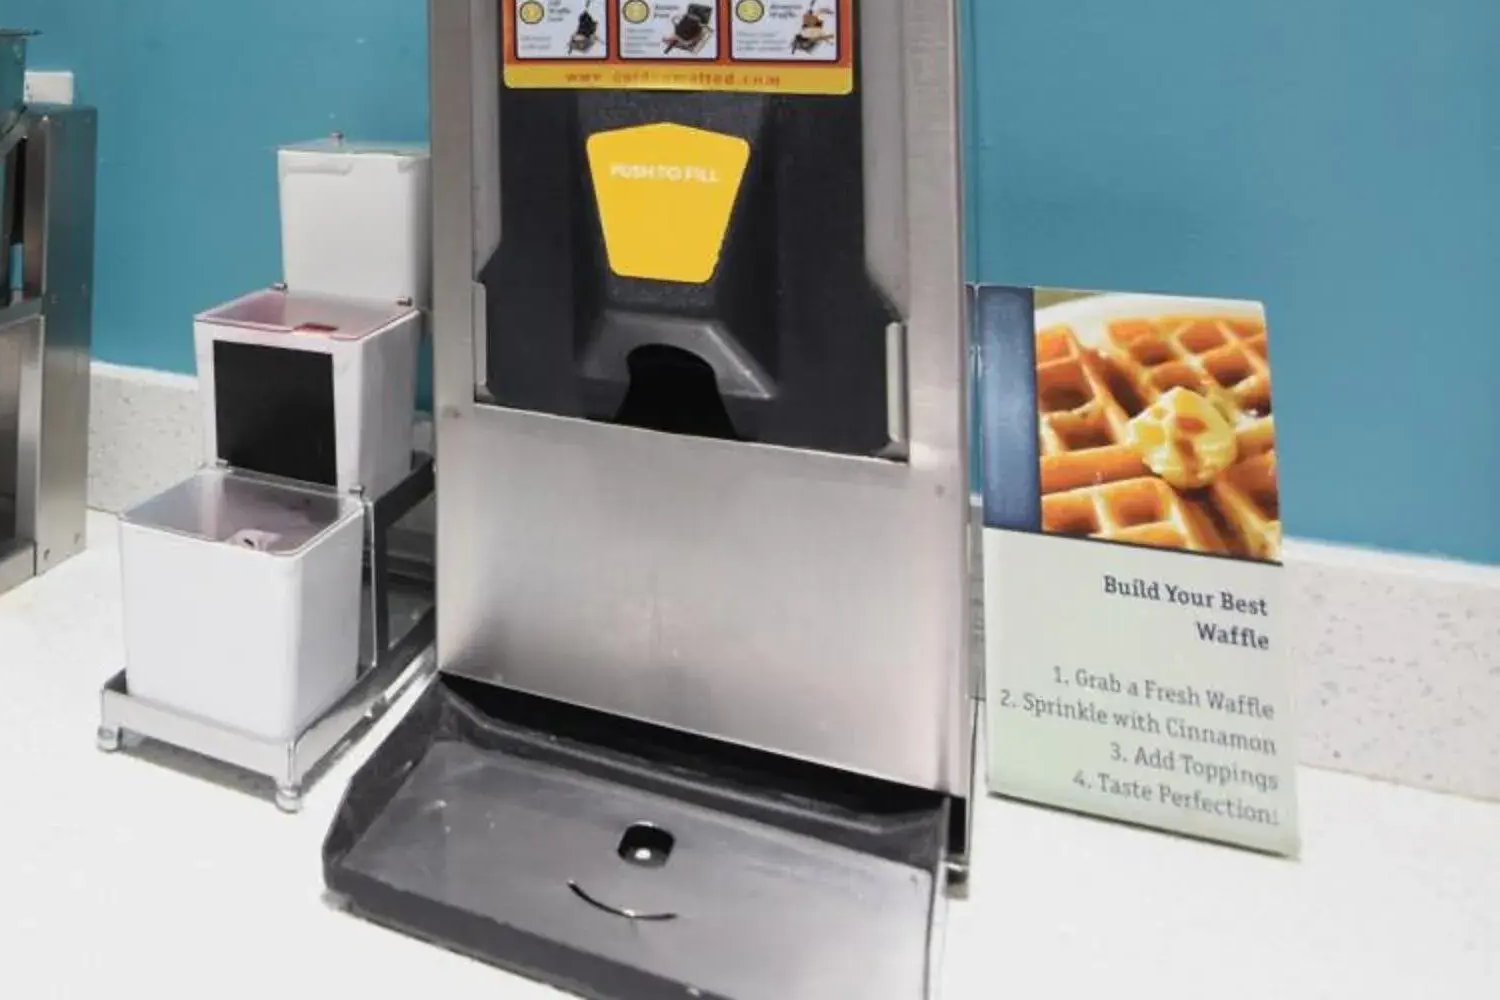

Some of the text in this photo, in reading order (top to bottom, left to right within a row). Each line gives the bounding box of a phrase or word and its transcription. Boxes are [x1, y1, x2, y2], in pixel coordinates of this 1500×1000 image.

[610, 163, 720, 183] PUSH TO FILL
[1103, 574, 1269, 617] Build Your Best
[1196, 621, 1270, 651] Waffle
[1052, 665, 1275, 721] 1. Grab a Fresh Waffle
[1000, 688, 1277, 756] 2. Sprinkle with Cinnamon
[1072, 769, 1092, 790] 4.
[1097, 772, 1152, 802] Taste
[1109, 741, 1280, 792] 3. Add Toppings
